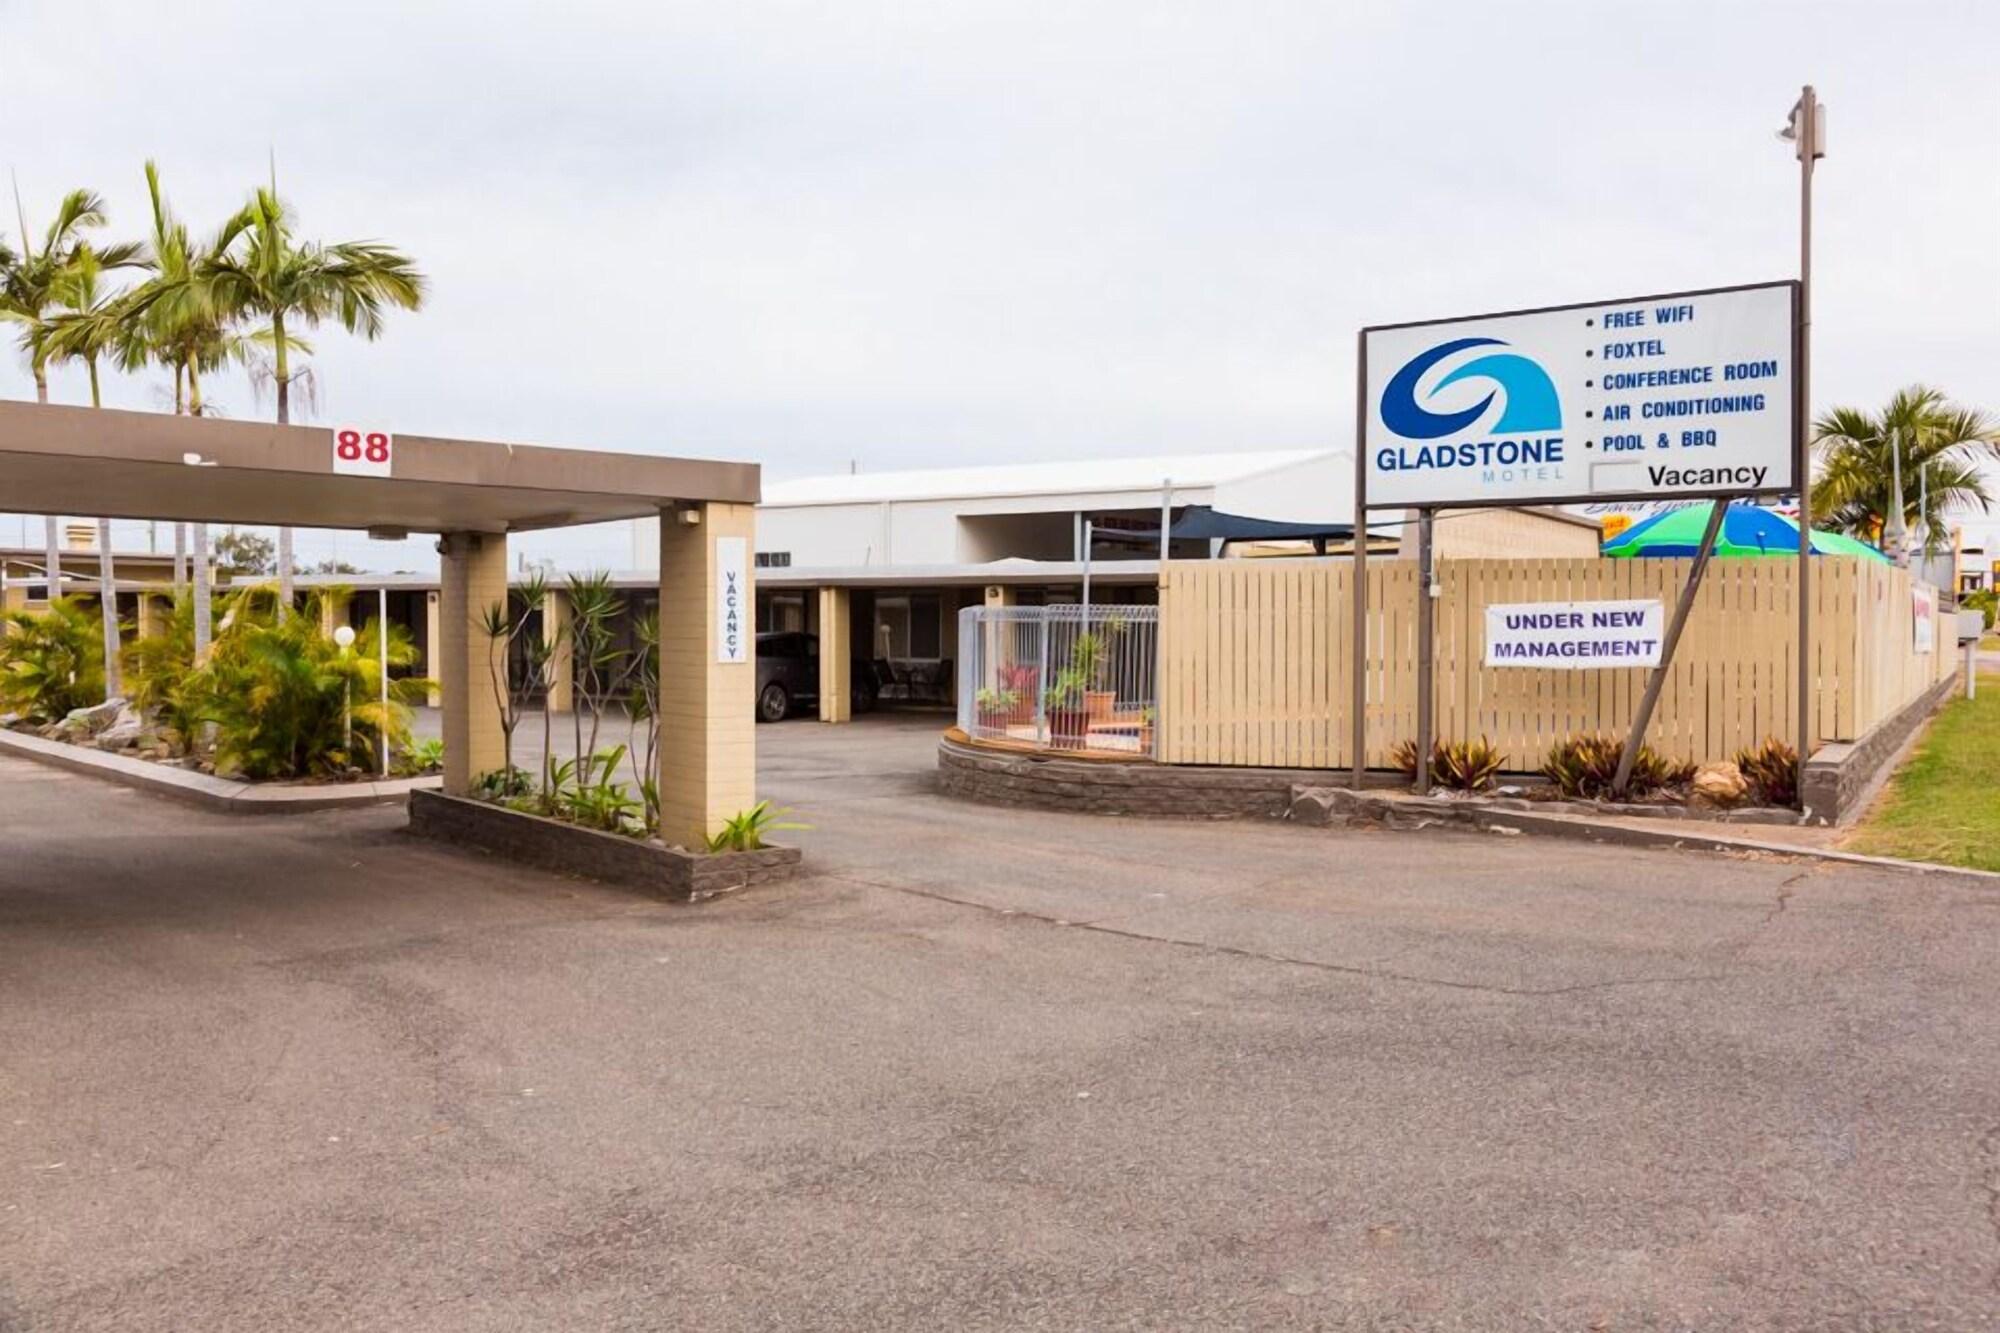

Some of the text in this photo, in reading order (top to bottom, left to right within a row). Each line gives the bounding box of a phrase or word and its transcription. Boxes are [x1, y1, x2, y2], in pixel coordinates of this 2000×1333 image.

[1604, 305, 1694, 329] FREE WIFI
[1604, 340, 1666, 360] FOXTEL
[1603, 360, 1777, 391] CONFERENCE ROOM
[1603, 394, 1766, 421] AIR CONDITIONING
[338, 431, 389, 463] 88
[1603, 430, 1717, 452] POOL & BBQ
[1377, 438, 1564, 471] GLADSTONE
[1483, 467, 1563, 483] MOTEL
[1648, 466, 1767, 487] Vacancy
[726, 571, 737, 658] VACANCY
[1506, 611, 1645, 630] UNDER NEW
[1494, 640, 1657, 658] MANAGEMENT
